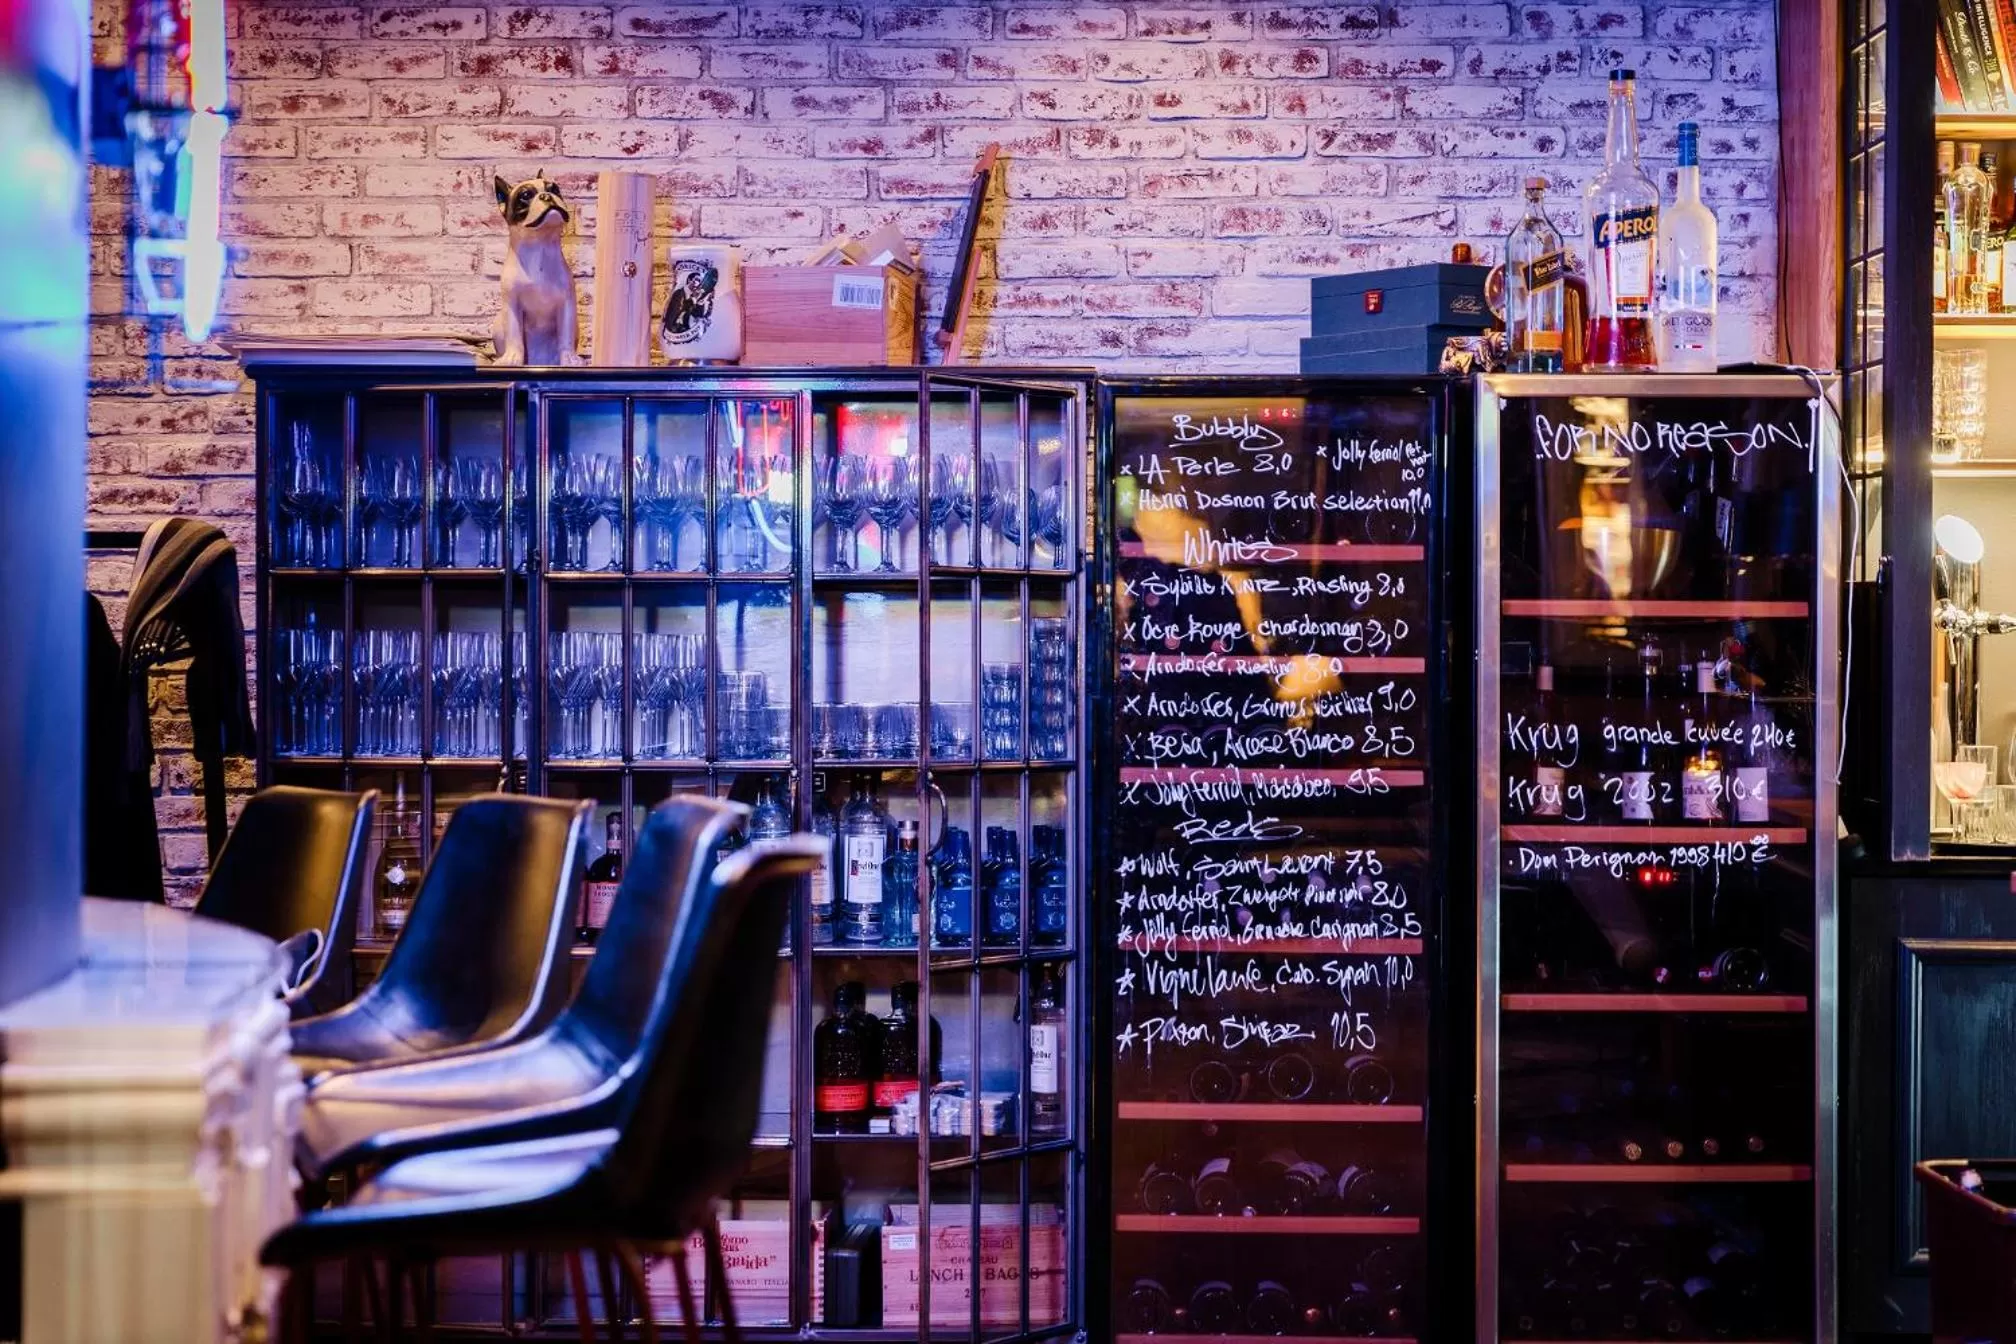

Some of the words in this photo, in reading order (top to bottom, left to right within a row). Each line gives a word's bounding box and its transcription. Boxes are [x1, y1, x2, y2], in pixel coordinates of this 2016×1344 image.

[1171, 413, 1284, 451] Bubbly
[1601, 422, 1651, 456] NO
[1170, 455, 1242, 477] Perle
[1252, 453, 1293, 476] 8,0
[1270, 489, 1317, 511] Brut
[1183, 527, 1299, 567] Whites
[1361, 725, 1415, 758] 8,5
[1506, 712, 1580, 769] Krug
[1602, 718, 1680, 752] grande
[1509, 776, 1588, 822] Krug
[1519, 847, 1558, 873] Dom
[1669, 846, 1709, 868] 1998
[1330, 1011, 1376, 1051] 10,5
[909, 1269, 964, 1282] LNCH
